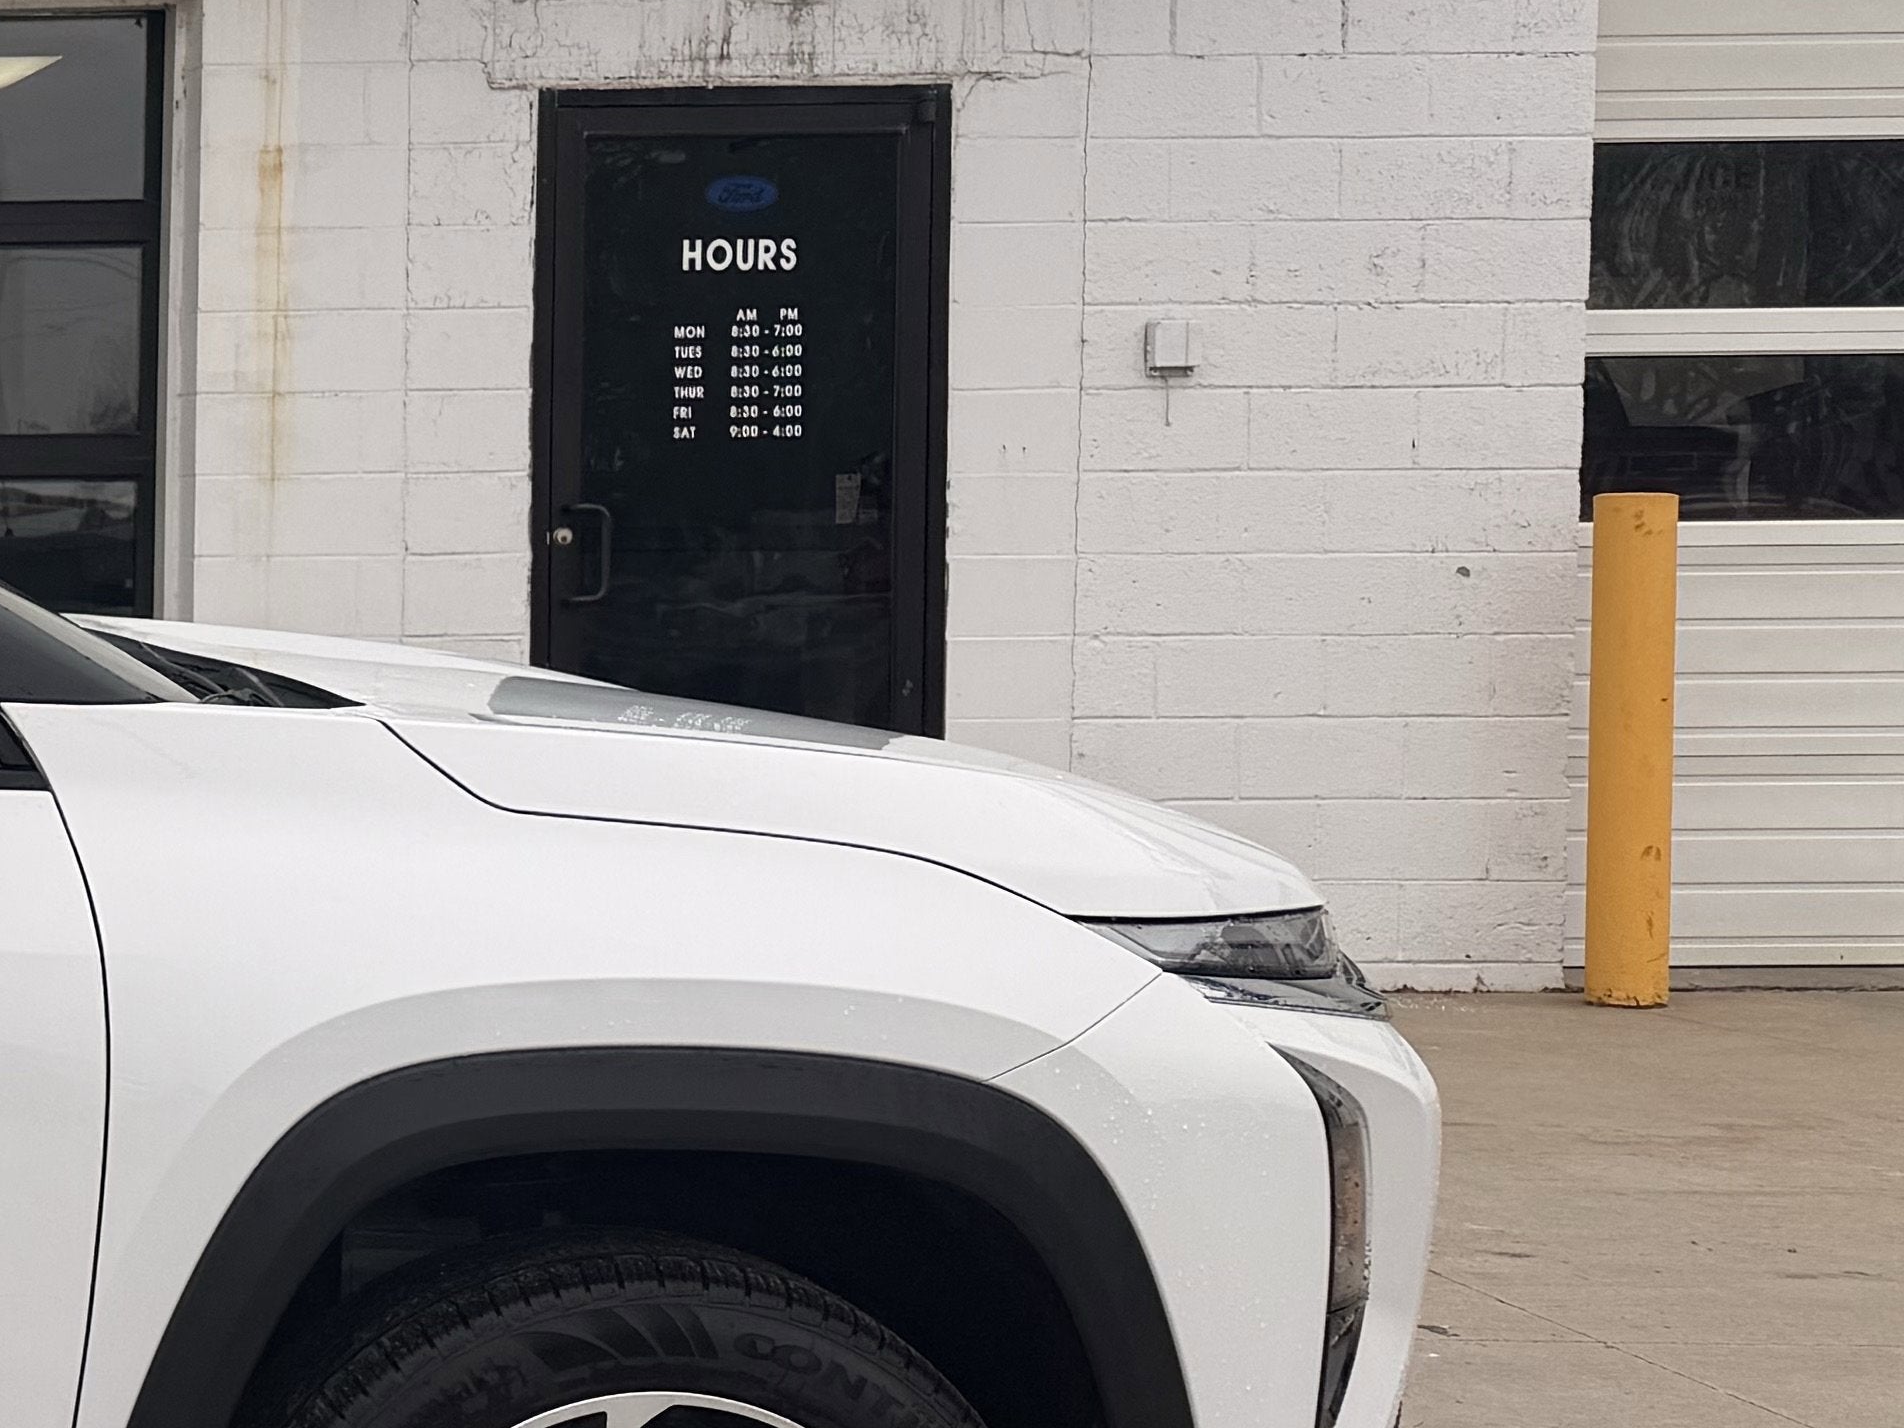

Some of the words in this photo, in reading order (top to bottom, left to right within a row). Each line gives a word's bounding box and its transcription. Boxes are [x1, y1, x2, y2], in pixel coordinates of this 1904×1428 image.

[682, 238, 797, 271] HOURS
[736, 309, 757, 321] AM
[780, 308, 798, 320] PM
[674, 326, 705, 338] MON
[731, 325, 760, 337] 8:30
[774, 324, 802, 337] 7:00
[674, 346, 702, 358] TUES
[731, 345, 759, 357] 8:30
[772, 344, 802, 357] 6:00
[674, 366, 702, 378] WED
[730, 366, 759, 377] 8:30
[772, 365, 802, 377] 6:00
[674, 386, 704, 398] THUR
[730, 386, 759, 398] 8:30
[773, 385, 802, 397] 7:00
[673, 406, 691, 419] FRI
[730, 406, 758, 417] 8:30
[773, 405, 802, 417] 6:00
[673, 426, 696, 439] SAT
[730, 425, 758, 438] 9:00
[773, 425, 802, 437] 4:00
